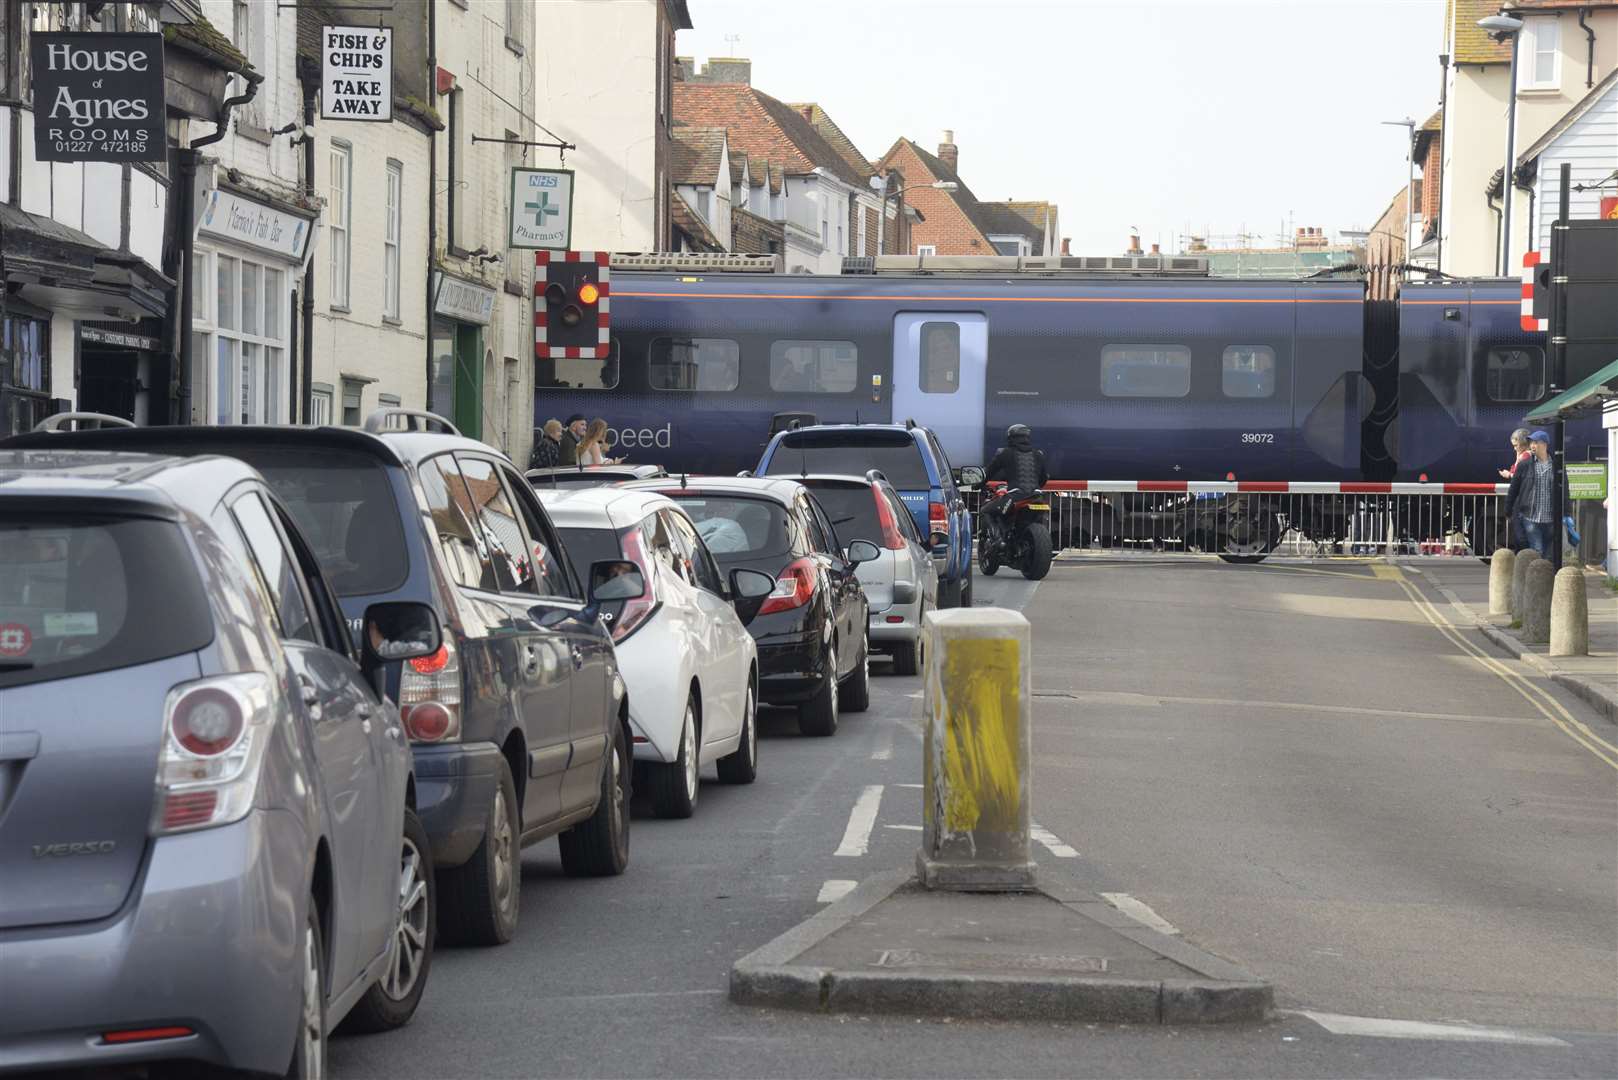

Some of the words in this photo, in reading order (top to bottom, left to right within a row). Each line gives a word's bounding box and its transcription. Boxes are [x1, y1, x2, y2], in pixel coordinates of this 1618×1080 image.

[328, 34, 368, 50] FISH
[373, 36, 386, 50] &
[47, 44, 148, 71] House
[330, 52, 383, 69] CHIPS
[92, 79, 103, 89] of
[333, 80, 381, 96] TAKE
[48, 86, 149, 127] Agnes
[332, 98, 381, 115] AWAY
[49, 128, 149, 141] ROOMS
[56, 141, 93, 152] 01227
[101, 141, 146, 153] 472185
[529, 175, 558, 187] NHS
[515, 225, 564, 241] Pharmacy
[1241, 433, 1274, 443] 39072
[32, 840, 116, 857] VERSO
